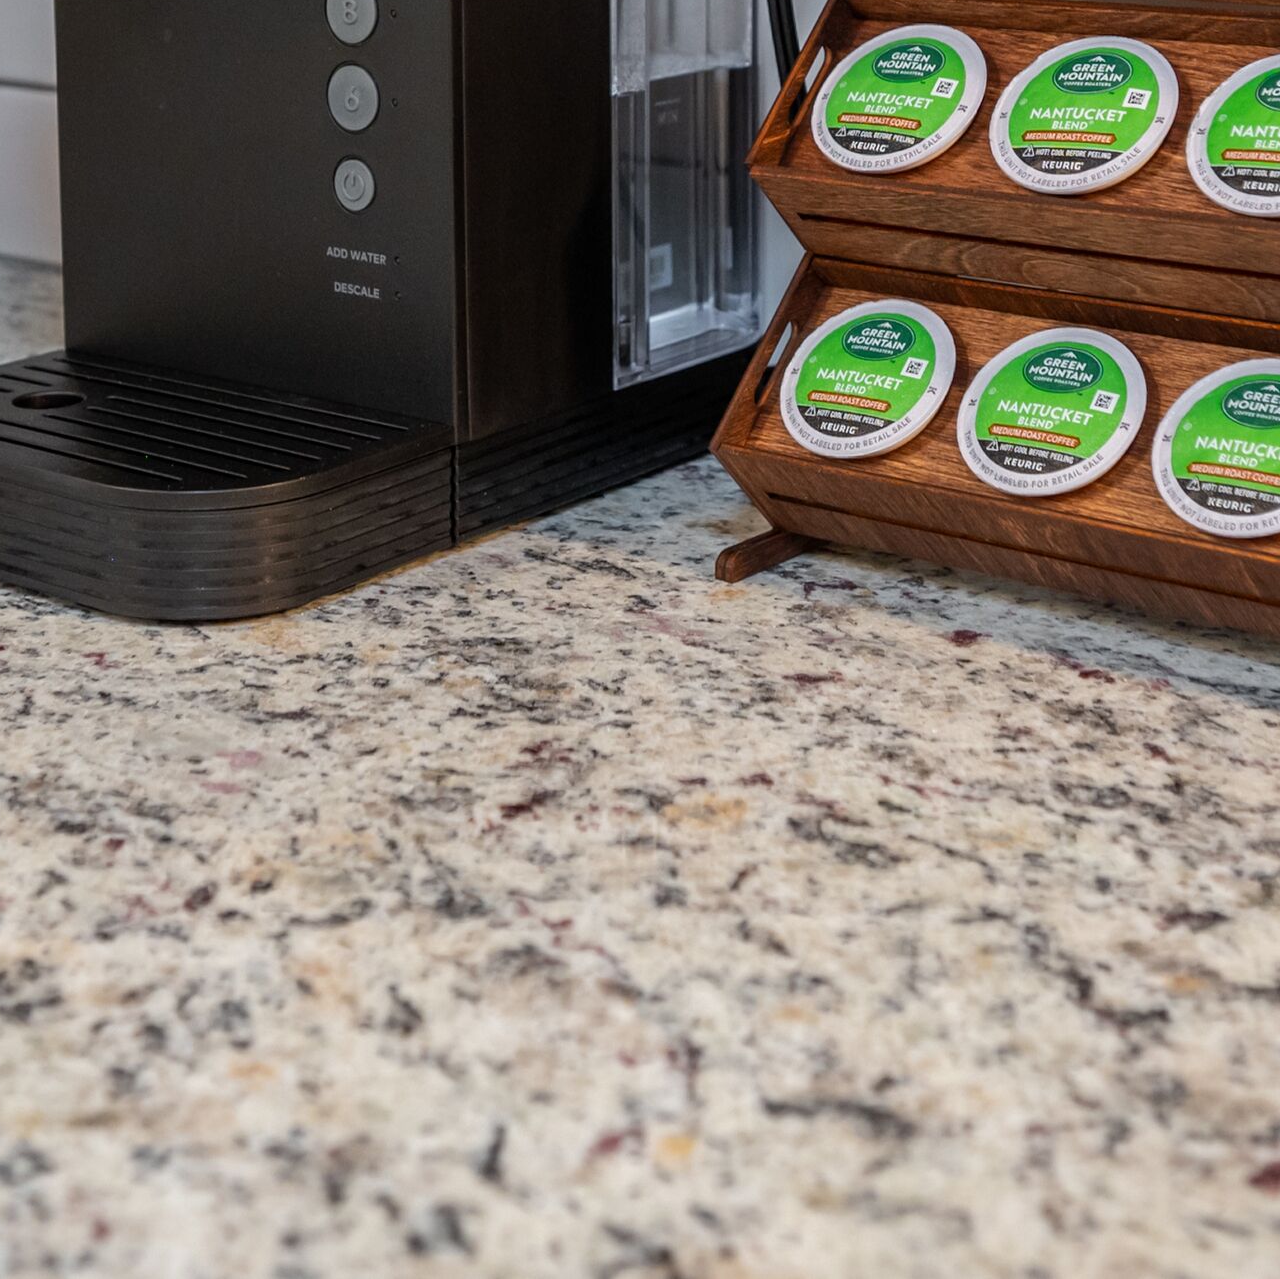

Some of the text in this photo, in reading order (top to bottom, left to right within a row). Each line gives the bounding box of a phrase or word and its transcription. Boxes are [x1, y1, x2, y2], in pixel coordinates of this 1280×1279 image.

[891, 52, 930, 62] GREEN
[877, 60, 936, 72] MOUNTAIN
[1072, 64, 1116, 72] GREEN
[1058, 72, 1124, 82] MOUNTAIN
[344, 86, 360, 113] 6
[847, 92, 933, 109] NANTUCKET
[864, 104, 898, 115] BLEND
[1030, 108, 1126, 121] NANTUCKET
[839, 114, 918, 129] MEDIUM ROAST COFFEE
[1051, 121, 1088, 130] BLEND
[1025, 132, 1056, 140] MEDIUM
[1081, 134, 1112, 143] COFFEE
[850, 141, 886, 152] KEURIG
[875, 133, 942, 167] FOR RETAIL SALE
[1225, 150, 1259, 160] MEDIUM
[1042, 160, 1081, 170] KEURIG
[326, 246, 387, 266] ADD WATER
[334, 281, 380, 299] DESCALE
[861, 327, 900, 340] GREEN
[847, 335, 906, 350] MOUNTAIN
[1043, 357, 1087, 371] GREEN
[817, 369, 903, 390] NANTUCKET
[1028, 365, 1094, 382] MOUNTAIN
[834, 383, 867, 395] BLEND
[809, 392, 887, 411] MEDIUM ROAST COFFEE
[997, 400, 1092, 425] NANTUCKET
[820, 421, 856, 435] KEURIG
[1017, 416, 1053, 430] BLEND
[863, 432, 890, 446] RETAIL
[891, 417, 911, 434] SALE
[990, 425, 1076, 447] MEDIUM ROAST COFFEE
[1004, 457, 1043, 472] KEURIG
[1219, 453, 1259, 468] BLEND
[1051, 469, 1081, 484] RETAIL
[1082, 454, 1103, 472] SALE
[1189, 462, 1224, 475] MEDIUM
[1223, 468, 1251, 480] ROAST
[1208, 497, 1251, 513] KEURIG
